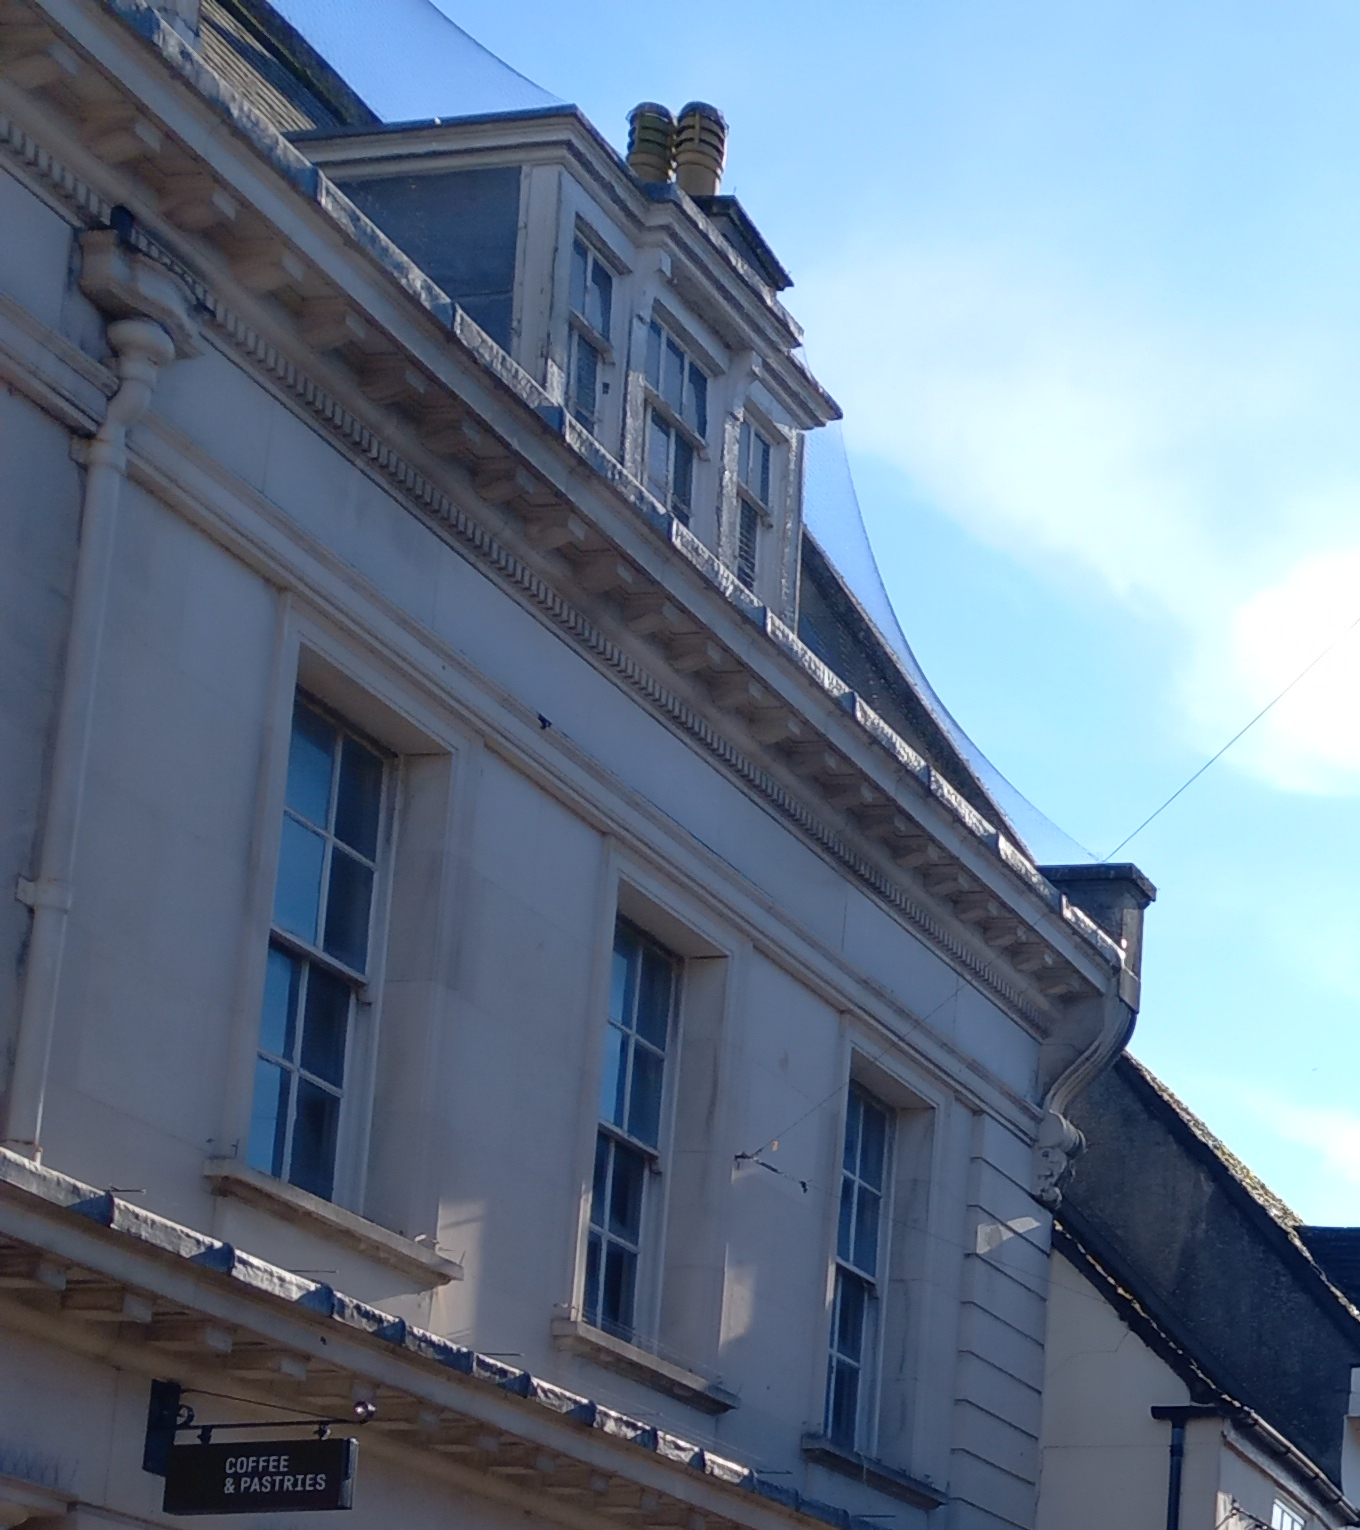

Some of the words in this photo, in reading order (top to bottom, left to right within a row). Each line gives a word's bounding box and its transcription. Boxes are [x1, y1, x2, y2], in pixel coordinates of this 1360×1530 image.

[225, 1455, 289, 1474] COFFEE
[224, 1477, 235, 1494] &
[240, 1474, 326, 1492] PASTRIES
